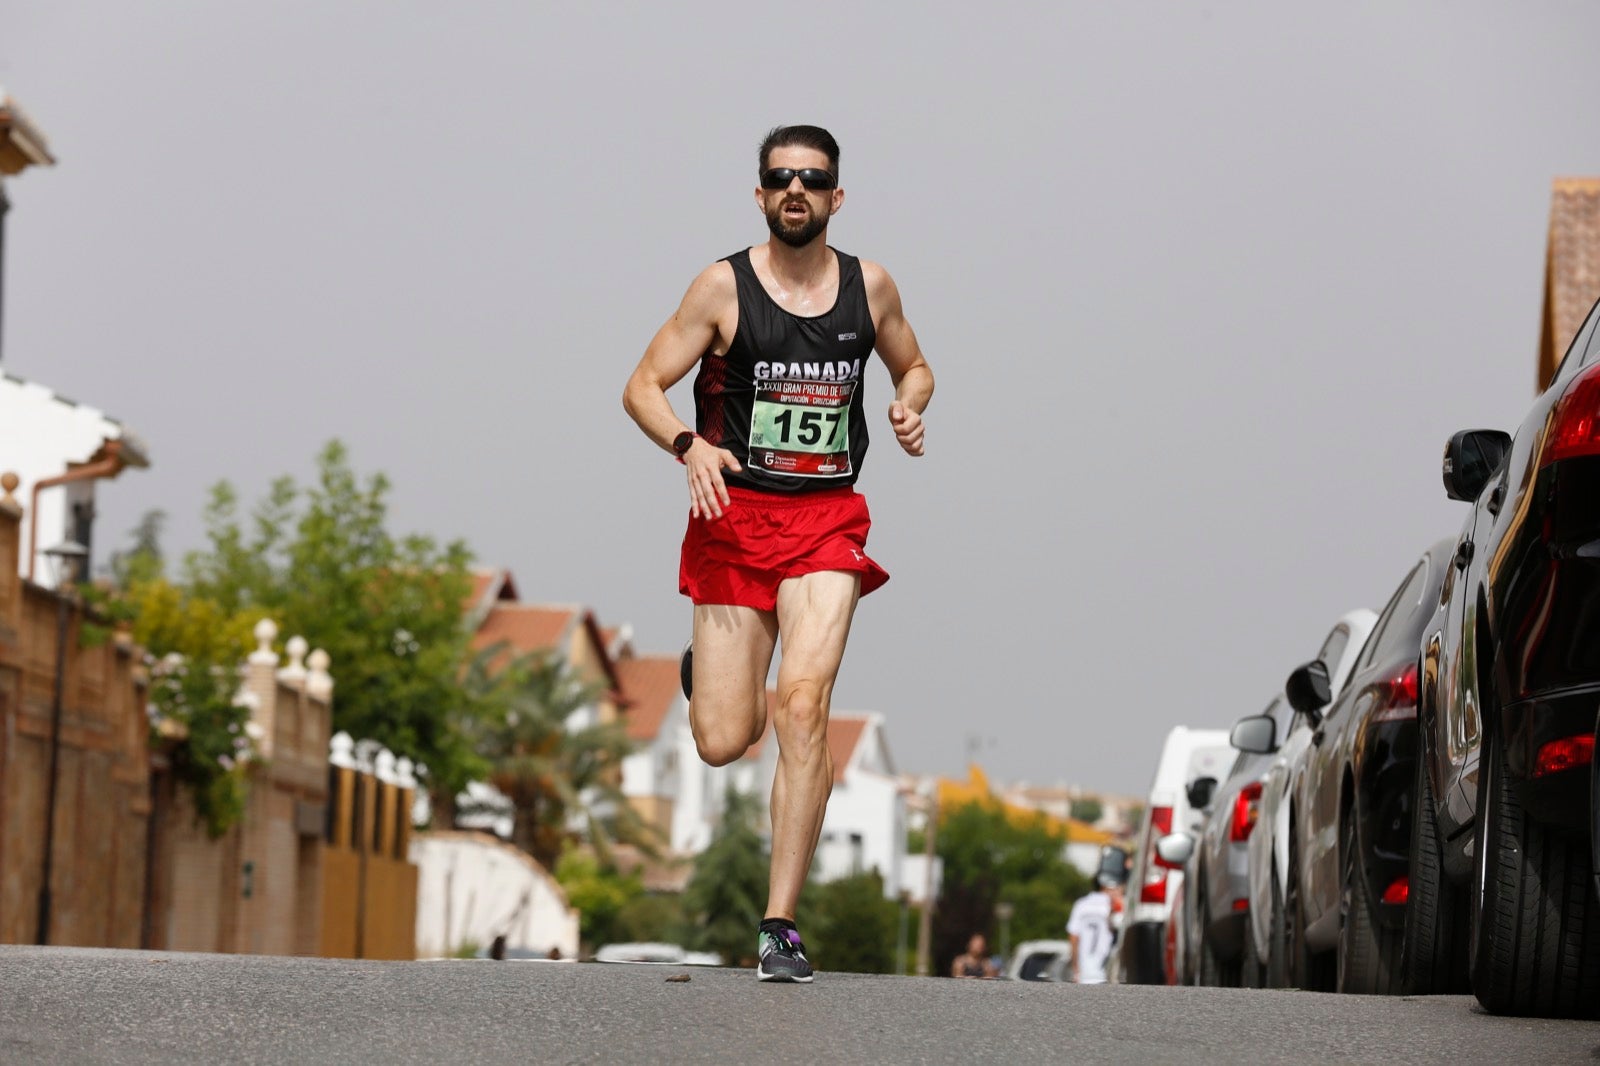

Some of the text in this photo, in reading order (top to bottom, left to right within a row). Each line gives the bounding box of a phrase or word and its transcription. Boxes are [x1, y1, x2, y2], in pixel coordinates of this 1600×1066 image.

[754, 359, 860, 381] GRANADA
[783, 382, 802, 394] GRAN
[803, 384, 829, 396] PREMIO
[830, 386, 839, 397] DE
[774, 409, 841, 446] 157
